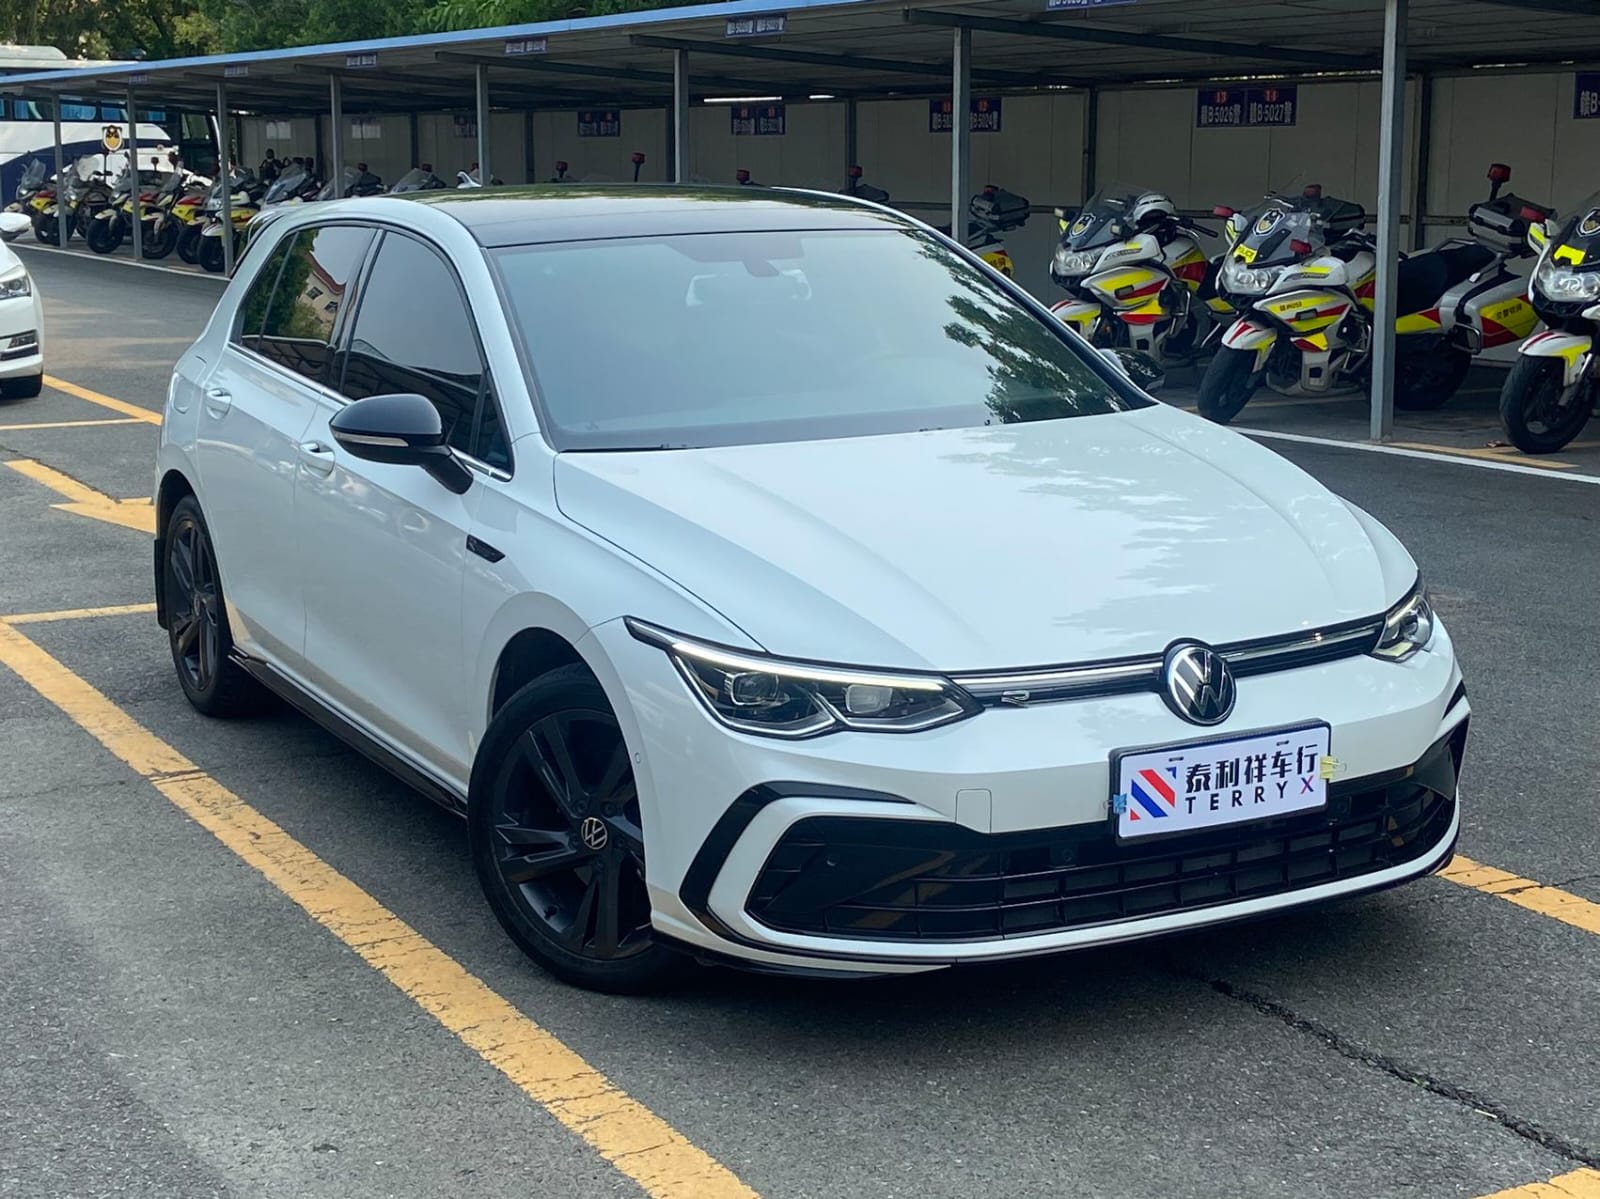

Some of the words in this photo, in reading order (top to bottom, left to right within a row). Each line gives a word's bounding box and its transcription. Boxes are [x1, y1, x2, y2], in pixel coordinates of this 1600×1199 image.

[1185, 744, 1318, 794] 泰利祥车行
